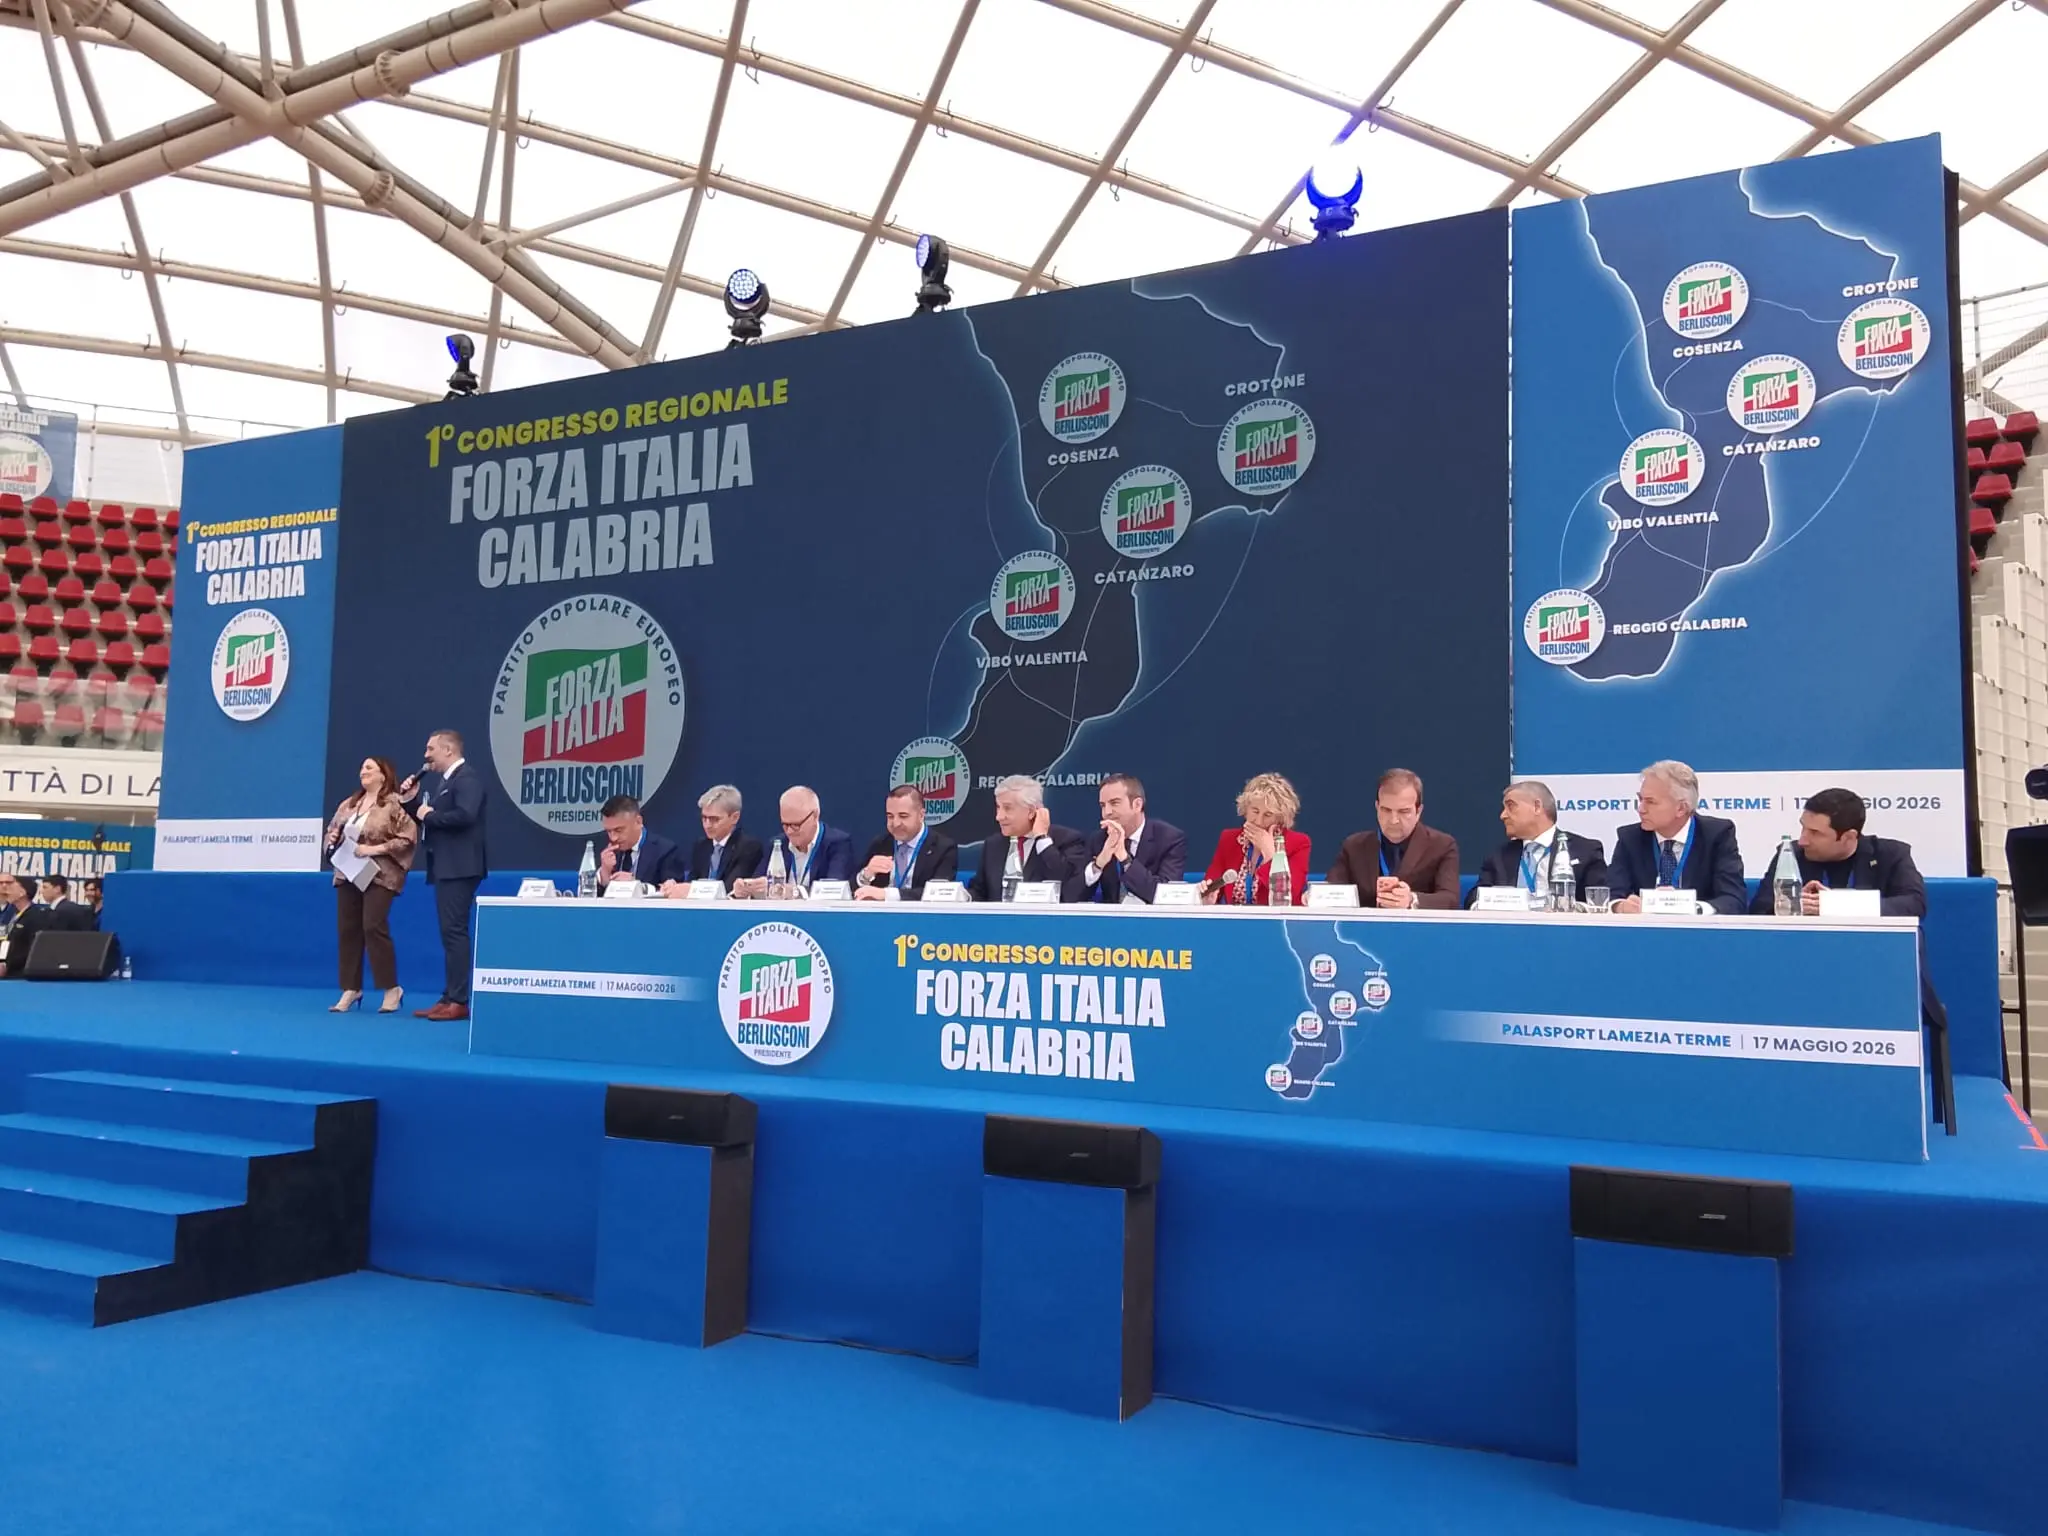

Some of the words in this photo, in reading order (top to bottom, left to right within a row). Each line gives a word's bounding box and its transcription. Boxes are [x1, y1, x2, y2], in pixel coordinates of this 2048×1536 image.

[1688, 280, 1720, 303] FORZA
[1842, 277, 1919, 297] CROTONE
[1688, 293, 1723, 316] ITALIA
[1679, 313, 1732, 331] BERLUSCONI
[1864, 317, 1900, 341] FORZA
[1672, 339, 1744, 358] COSENZA
[1864, 330, 1903, 355] ITALIA
[1855, 352, 1913, 370] BERLUSCONI
[1064, 373, 1099, 400] FORZA
[1224, 373, 1305, 396] CROTONE
[1753, 373, 1787, 397] FORZA
[1064, 390, 1100, 416] ITALIA
[1753, 386, 1790, 410] ITALIA
[457, 408, 619, 454] CONGRESSO
[625, 378, 788, 428] REGIONALE
[1055, 414, 1109, 435] BERLUSCONI
[1744, 408, 1799, 425] BERLUSCONI
[1246, 421, 1284, 449] FORZA
[1723, 436, 1820, 456] CATANZARO
[1047, 446, 1119, 466] COSENZA
[1246, 438, 1286, 466] ITALIA
[1644, 446, 1677, 471] FORZA
[450, 448, 589, 524] FORZA
[600, 423, 753, 505] ITALIA
[1235, 464, 1297, 485] BERLUSCONI
[1644, 459, 1680, 483] ITALIA
[1127, 487, 1163, 515] FORZA
[1636, 482, 1689, 498] BERLUSCONI
[200, 517, 269, 537] CONGRESSO
[270, 508, 338, 529] REGIONALE
[1127, 503, 1165, 530] ITALIA
[1607, 518, 1643, 531] VIBO
[1646, 511, 1720, 527] VALENTIA
[195, 536, 255, 573] FORZA
[259, 528, 323, 566] ITALIA
[478, 502, 714, 589] CALABRIA
[1117, 529, 1174, 548] BERLUSCONI
[207, 565, 305, 605] CALABRIA
[1015, 572, 1049, 600] FORZA
[1094, 564, 1195, 584] CATANZARO
[1015, 587, 1050, 613] ITALIA
[1005, 613, 1059, 631] BERLUSCONI
[1547, 607, 1579, 629] FORZA
[1547, 619, 1582, 641] ITALIA
[1613, 622, 1668, 635] REGGIO
[1670, 617, 1748, 632] CALABRIA
[494, 632, 534, 714] PARTITO
[539, 597, 632, 631] POPOLARE
[636, 615, 681, 706] EUROPEO
[976, 655, 1011, 668] VIBO
[1015, 650, 1088, 667] VALENTIA
[1539, 642, 1590, 655] BERLUSCONI
[546, 653, 623, 714] FORZA
[223, 687, 272, 706] BERLUSCONI
[544, 695, 625, 758] ITALIA
[2, 766, 67, 794] TTÀ
[81, 773, 113, 795] DI
[913, 759, 945, 783] FORZA
[979, 776, 1004, 788] REG
[520, 765, 644, 804] BERLUSCONI
[914, 774, 946, 794] TALIA
[548, 810, 604, 822] PRESIDENT
[1556, 799, 1630, 811] LASPORT
[1710, 798, 1771, 810] TERME
[1896, 797, 1941, 810] 2026
[0, 835, 60, 849] NGRESSO
[62, 839, 131, 852] REGINALE
[2, 850, 45, 877] RZA
[721, 941, 744, 988] PARTITO
[748, 924, 802, 940] POPOLARE
[805, 938, 831, 993] EUROPEO
[921, 942, 1055, 965] CONGRESSO
[1059, 945, 1193, 970] REGIONALE
[481, 976, 529, 987] PALASPORT
[530, 978, 567, 988] LAMEZIA
[568, 980, 596, 990] TERME
[607, 981, 616, 991] 17
[616, 982, 653, 992] MAGGIO
[654, 983, 676, 993] 2026
[751, 958, 797, 995] FORZA
[751, 979, 799, 1018] ITALIA
[915, 969, 1032, 1021] FORZA
[1041, 973, 1166, 1028] ITALIA
[738, 1022, 810, 1048] BERLUSCONI
[1502, 1023, 1595, 1040] PALASPORT
[1599, 1028, 1672, 1044] LAMEZIA
[1674, 1032, 1731, 1047] TERME
[1753, 1036, 1769, 1049] 17
[1774, 1038, 1848, 1053] MAGGIO
[1852, 1041, 1896, 1055] 2026
[754, 1049, 792, 1059] PRESIDENTE
[940, 1022, 1135, 1083] CALABRIA
